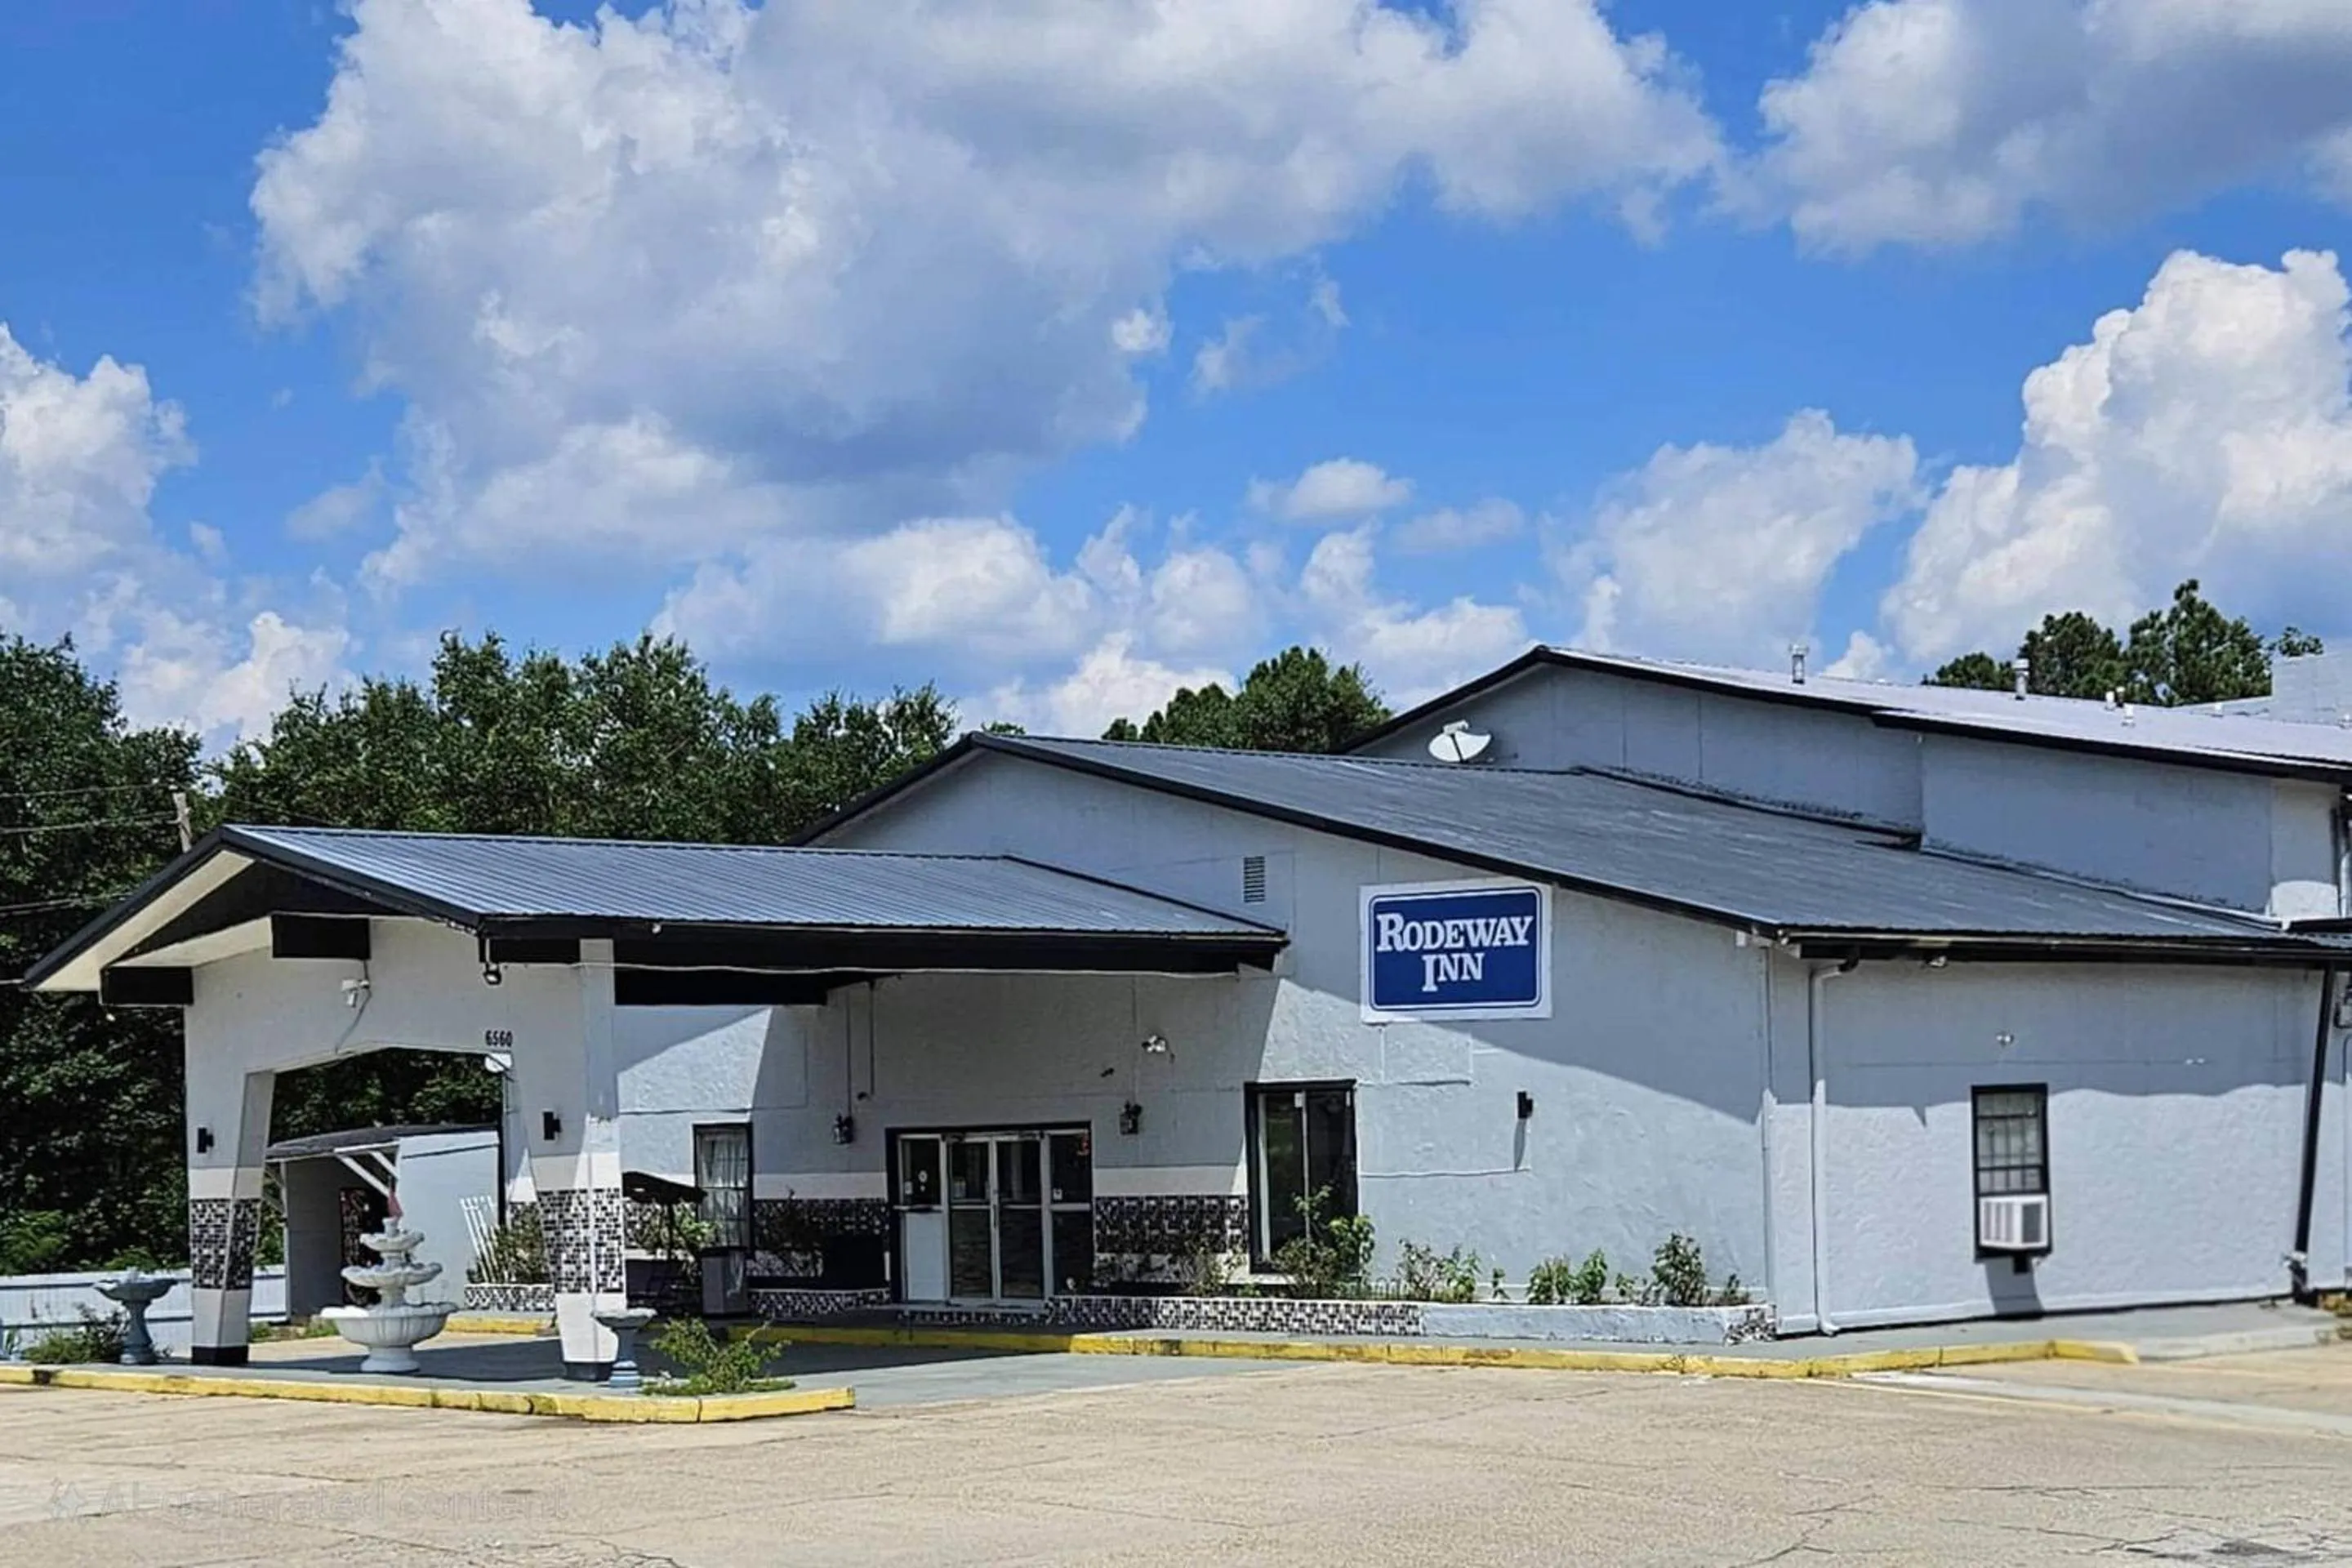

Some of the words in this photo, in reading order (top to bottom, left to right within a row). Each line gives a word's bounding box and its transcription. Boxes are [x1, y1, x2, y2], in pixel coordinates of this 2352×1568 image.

[1376, 912, 1534, 951] RODEWAY
[1421, 952, 1484, 992] INN
[485, 1030, 513, 1047] 6560
